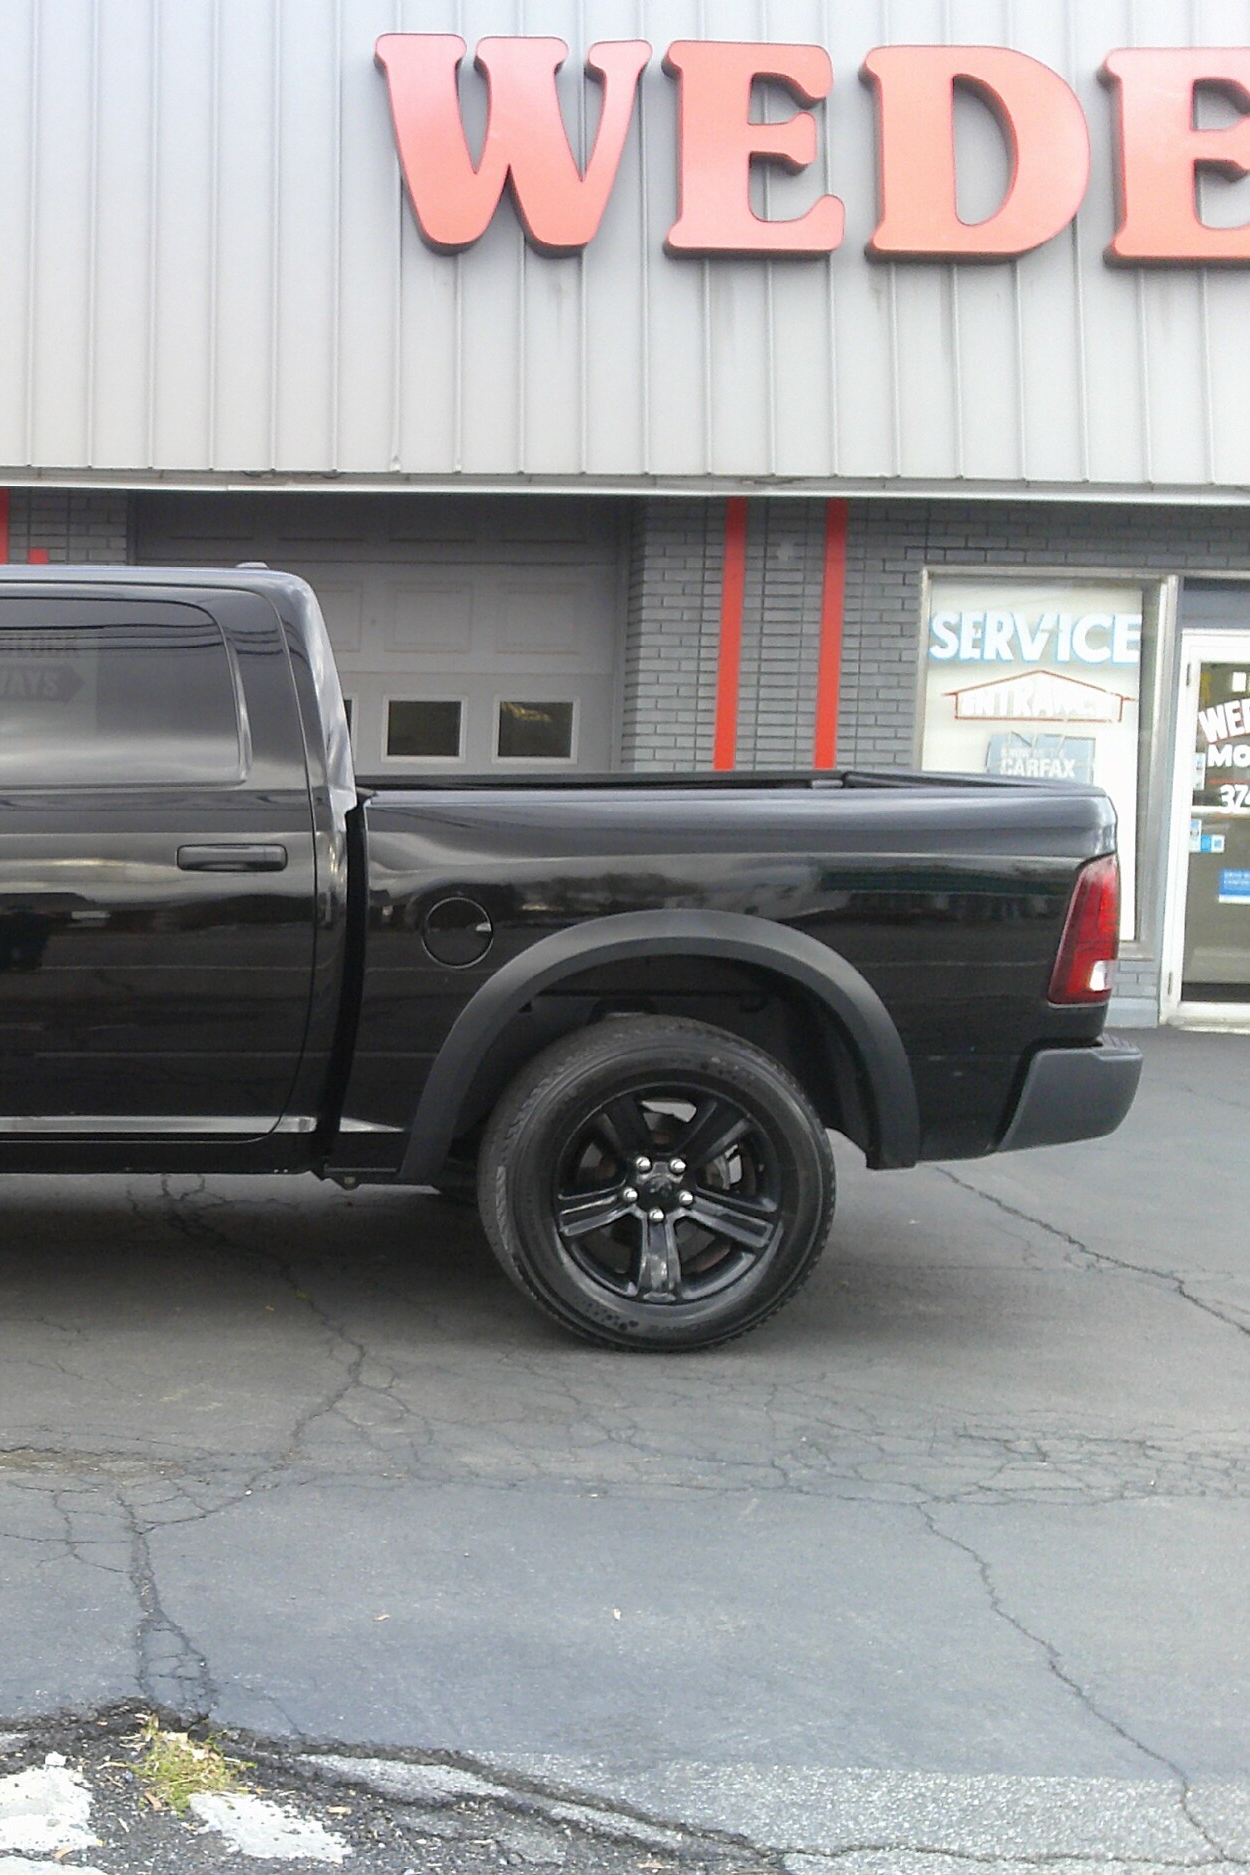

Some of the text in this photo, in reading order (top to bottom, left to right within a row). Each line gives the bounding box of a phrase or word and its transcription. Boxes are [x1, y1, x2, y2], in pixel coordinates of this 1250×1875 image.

[374, 33, 1250, 267] WEDE
[929, 611, 1141, 664] SERVICE
[999, 758, 1076, 779] CARFAX
